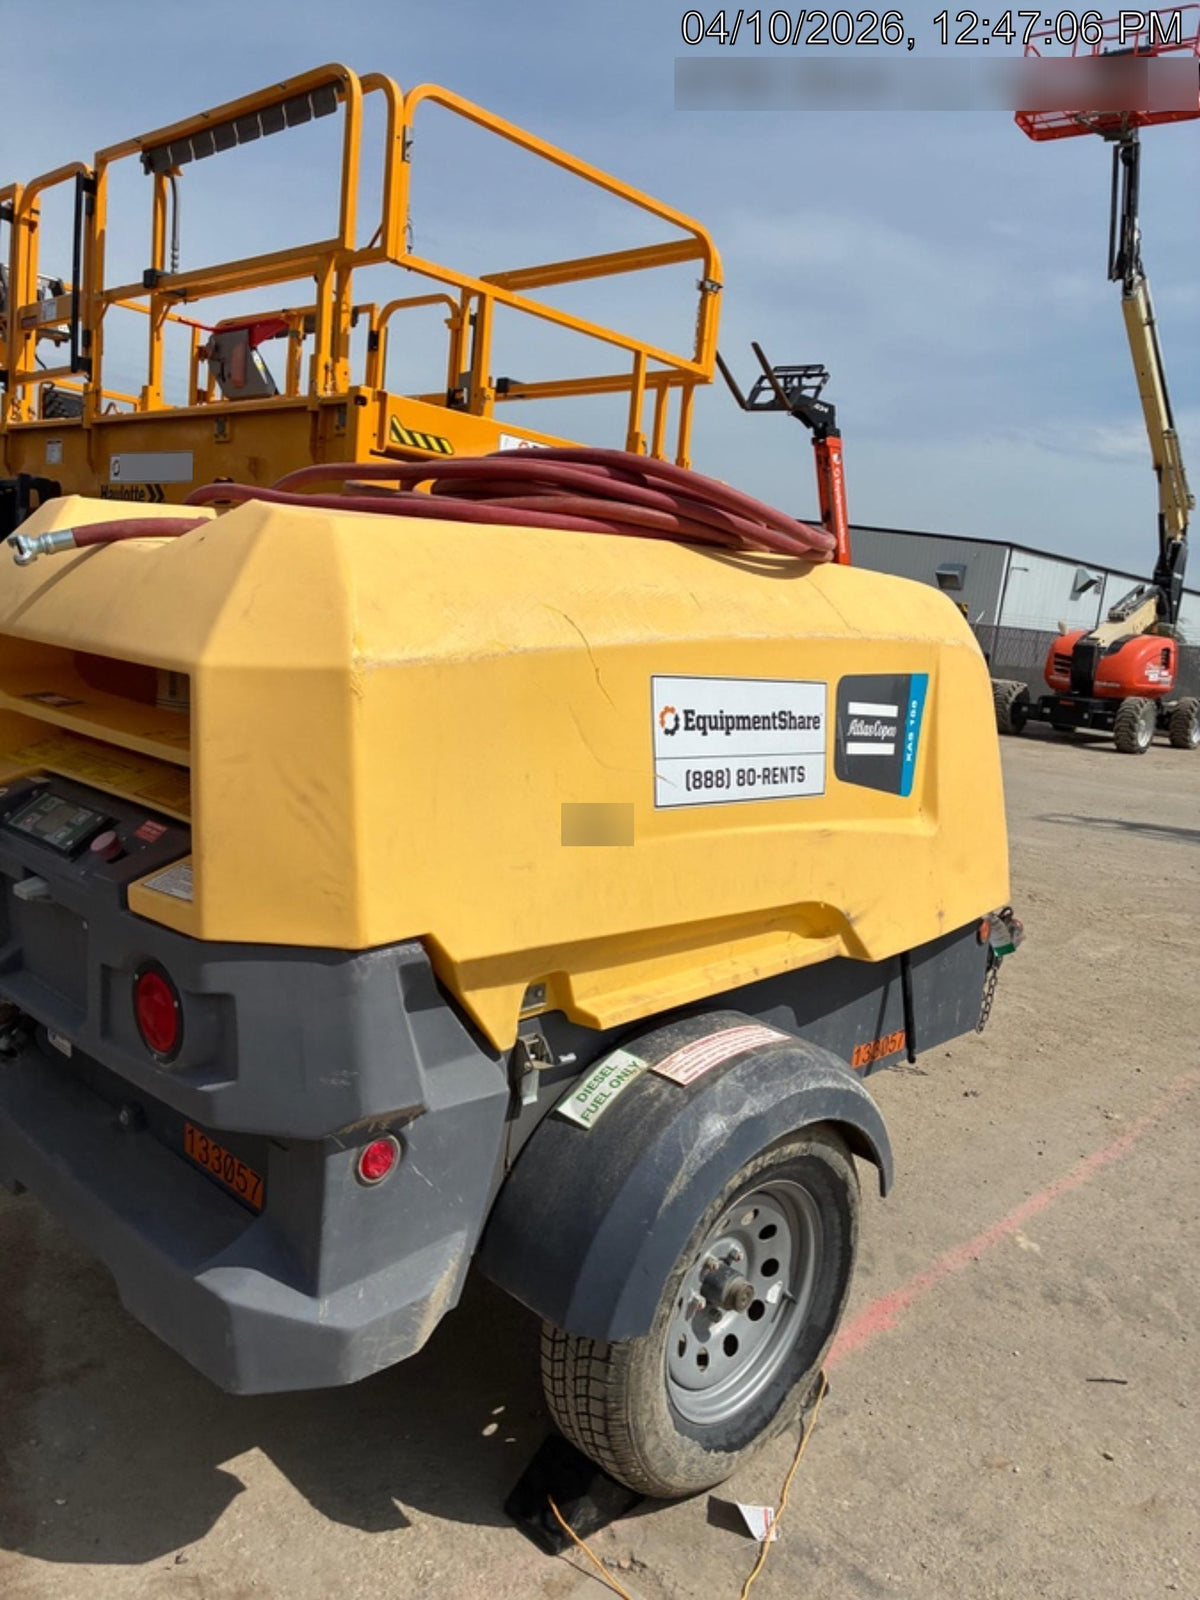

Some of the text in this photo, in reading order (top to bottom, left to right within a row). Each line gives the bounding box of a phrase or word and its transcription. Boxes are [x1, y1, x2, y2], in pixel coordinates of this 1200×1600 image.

[683, 709, 821, 736] EquipmentShare
[685, 766, 806, 791] (888) 80-RENTS
[576, 1065, 618, 1103] DIESEL
[580, 1061, 639, 1121] FUEL ONLY
[187, 1128, 262, 1201] 133057
